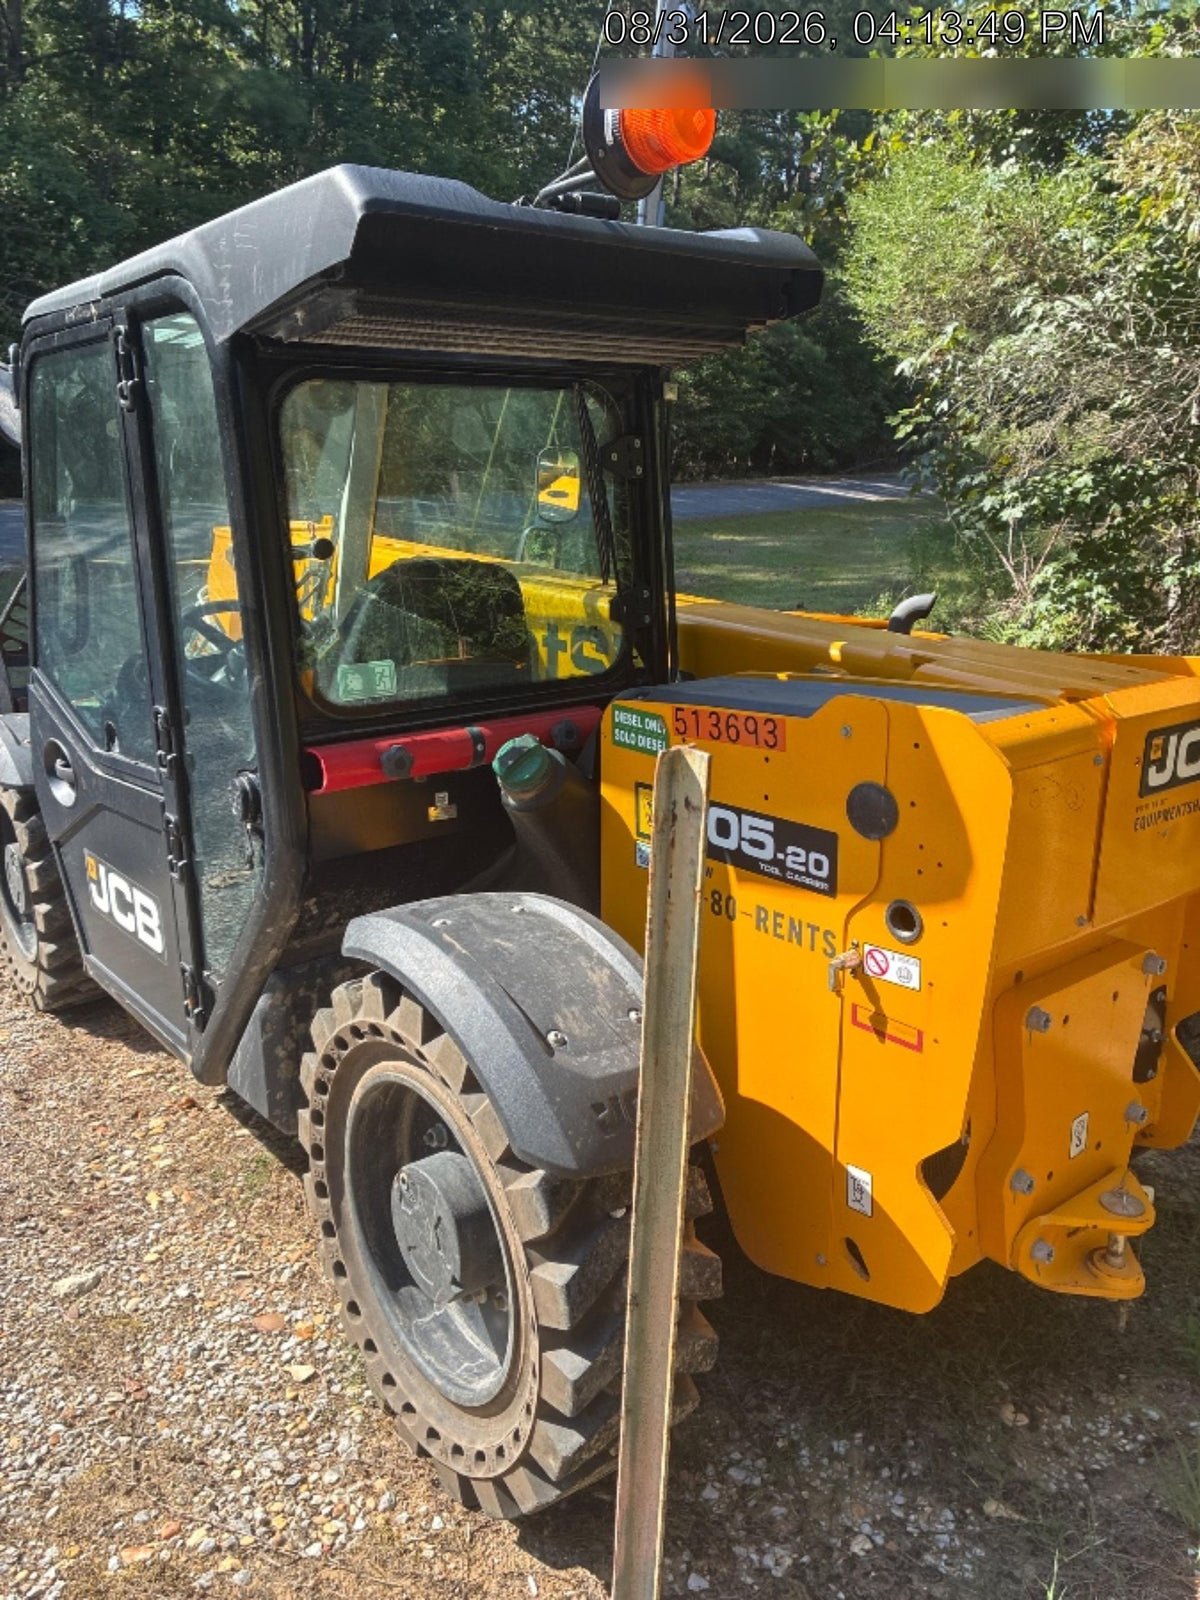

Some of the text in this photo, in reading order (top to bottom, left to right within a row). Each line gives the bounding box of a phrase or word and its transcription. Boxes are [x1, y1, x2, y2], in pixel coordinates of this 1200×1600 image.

[614, 710, 643, 728] DIESEL
[675, 707, 778, 749] 513693
[614, 728, 636, 745] SOLO
[89, 863, 163, 954] JCB
